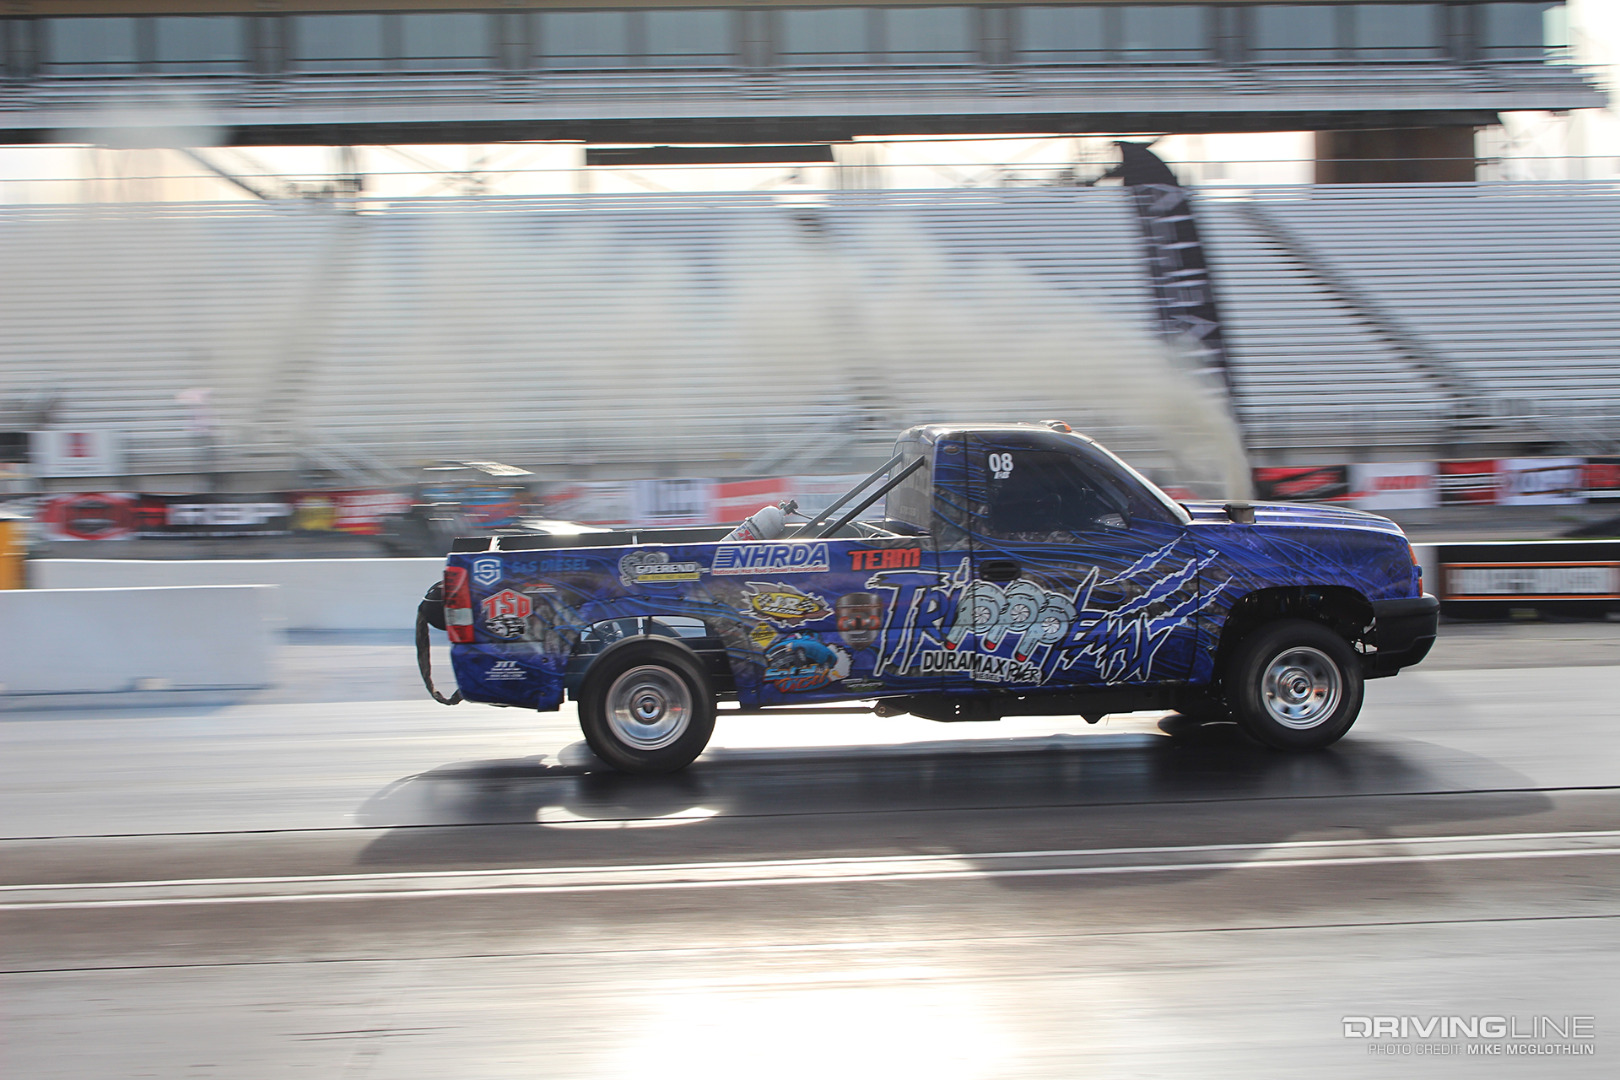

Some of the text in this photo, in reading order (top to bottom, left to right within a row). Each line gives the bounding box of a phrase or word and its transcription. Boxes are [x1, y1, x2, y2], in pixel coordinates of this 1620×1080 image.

[989, 453, 1014, 472] 08
[540, 559, 590, 571] DIESEL
[714, 546, 828, 568] NHRDA
[848, 548, 921, 571] TEAM
[483, 592, 531, 618] TSD
[922, 651, 1007, 676] DURAMAX
